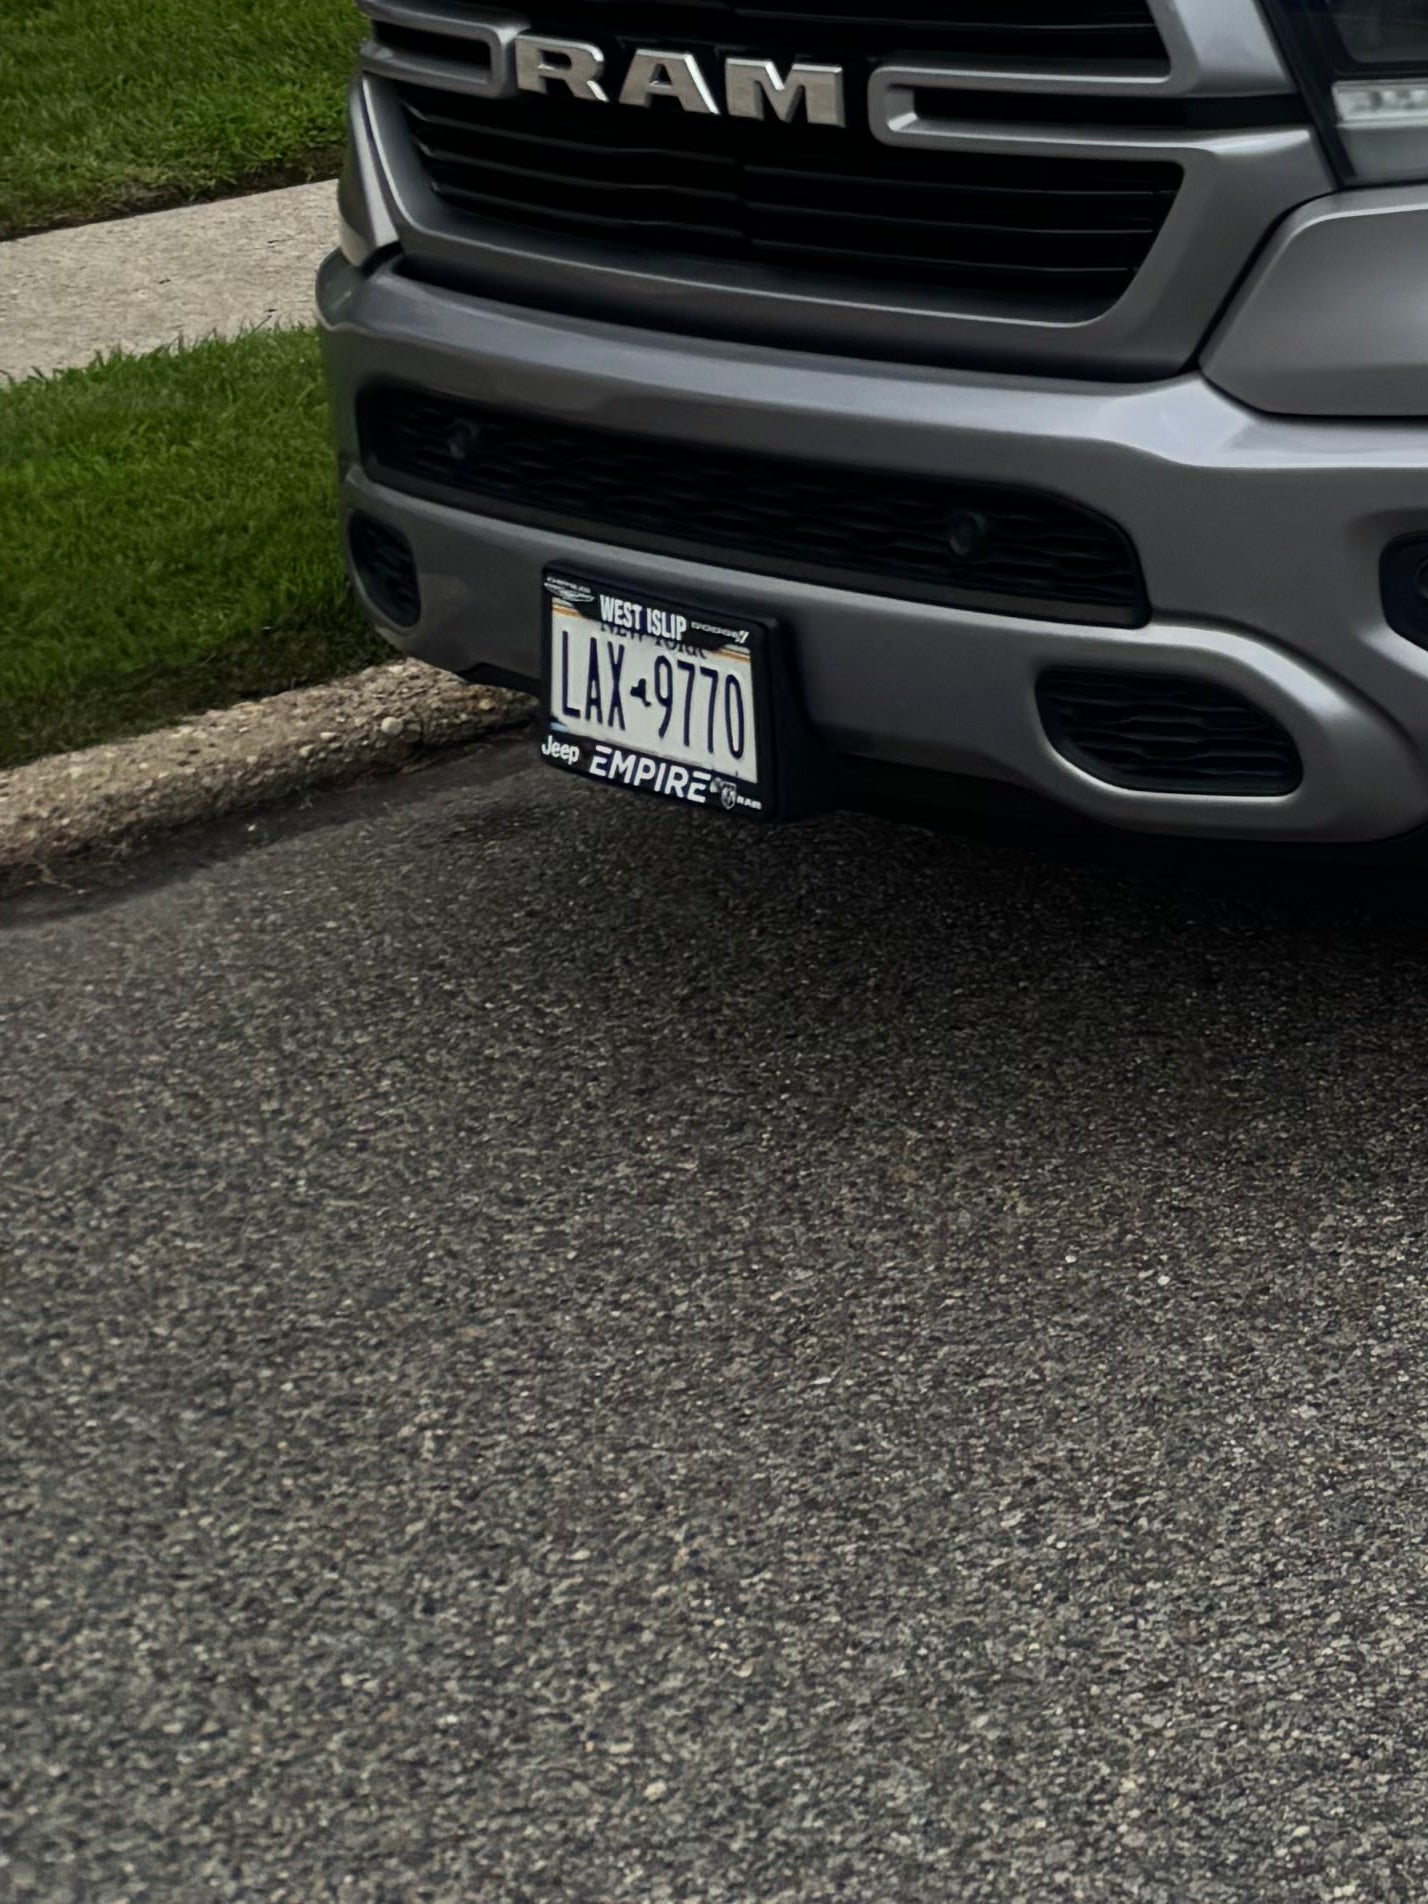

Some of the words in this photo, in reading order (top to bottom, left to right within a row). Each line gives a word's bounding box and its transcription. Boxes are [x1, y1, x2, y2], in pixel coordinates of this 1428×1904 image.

[514, 33, 847, 129] RAM
[599, 593, 643, 631] WEST
[646, 607, 687, 641] ISLIP
[560, 629, 627, 732] LAX
[653, 655, 746, 760] 9770
[541, 734, 580, 766] Jeep
[588, 744, 712, 804] EMPIRE
